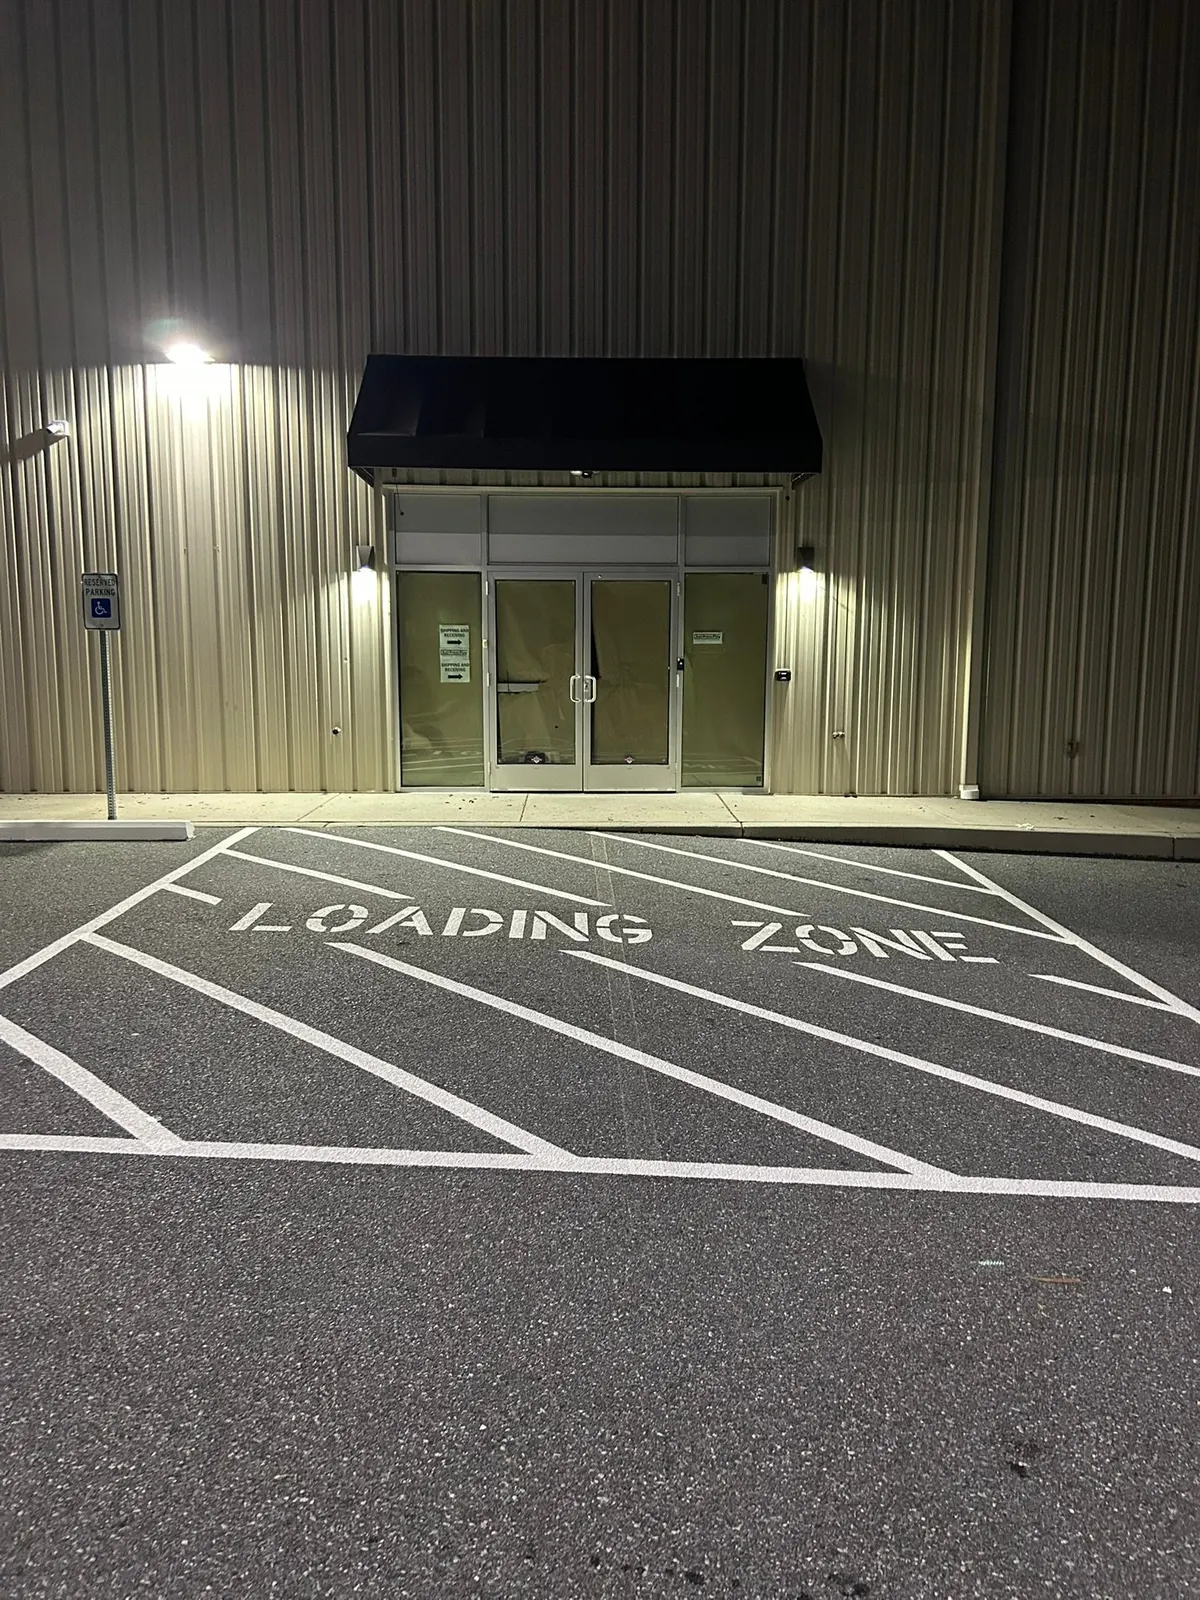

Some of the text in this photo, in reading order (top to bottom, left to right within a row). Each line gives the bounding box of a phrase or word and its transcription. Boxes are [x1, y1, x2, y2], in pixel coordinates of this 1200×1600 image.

[84, 578, 116, 587] RESERVED
[85, 588, 116, 597] PARKING
[228, 902, 1000, 964] LOADING ZONE
